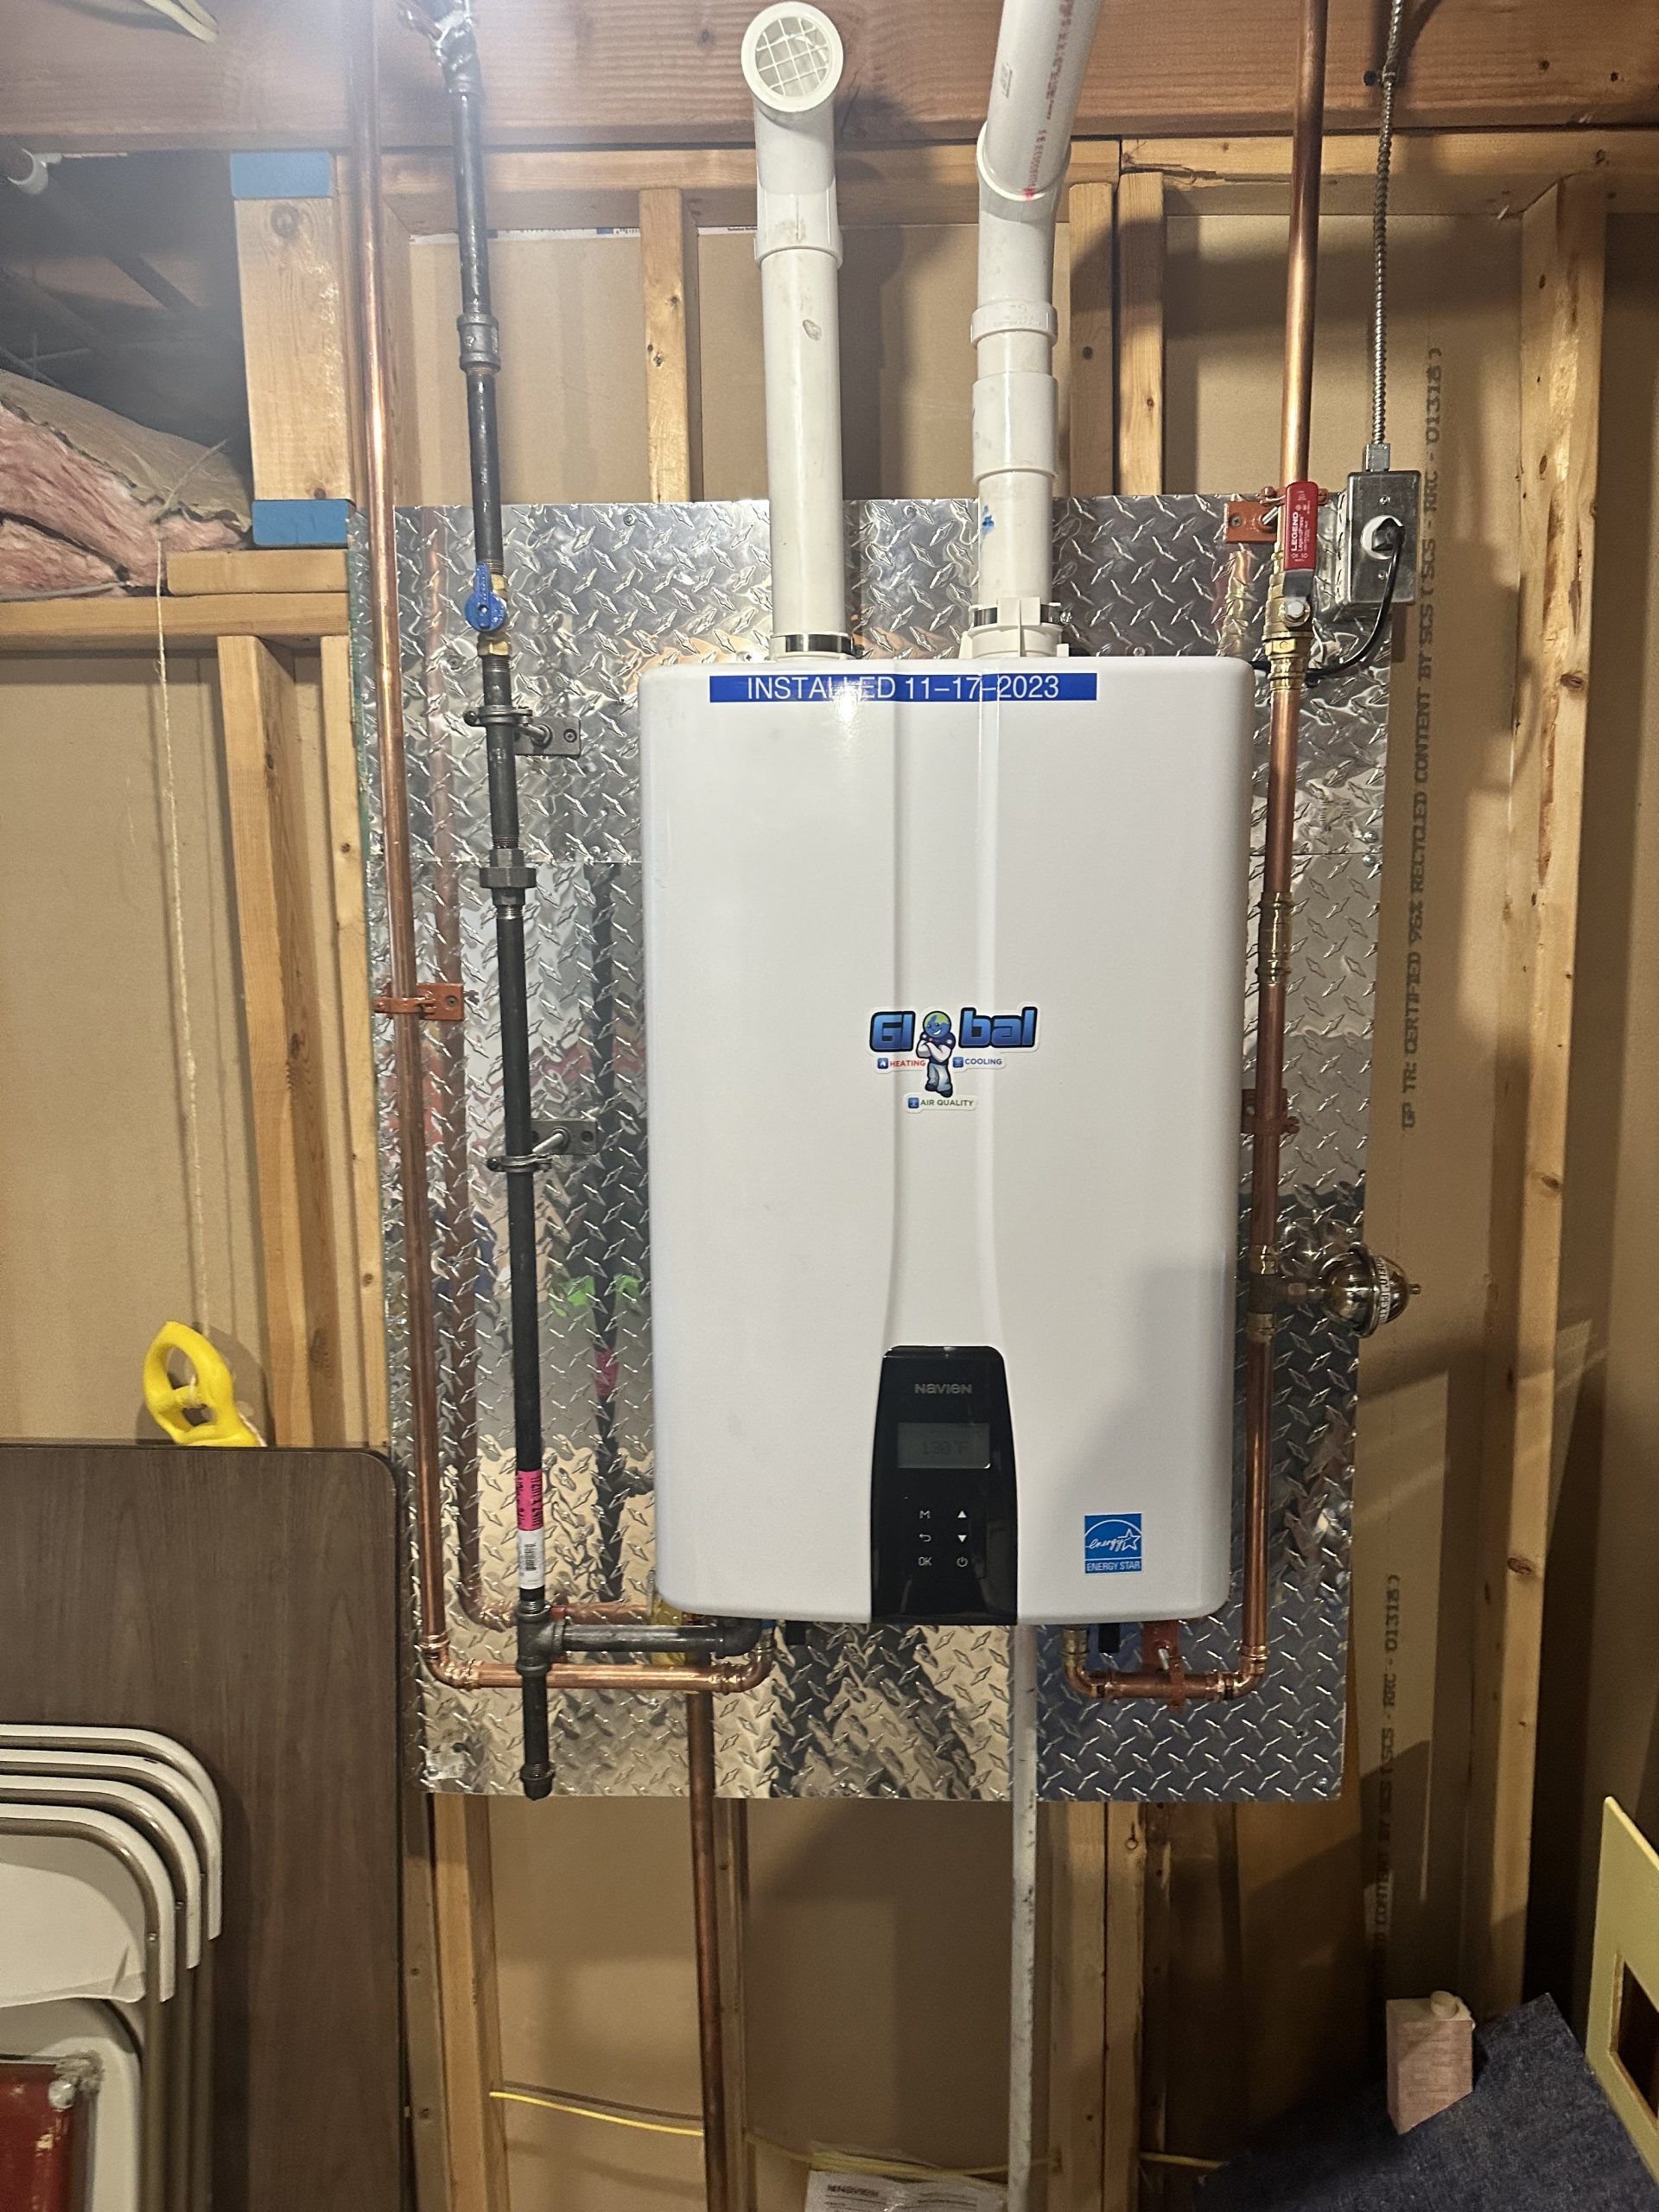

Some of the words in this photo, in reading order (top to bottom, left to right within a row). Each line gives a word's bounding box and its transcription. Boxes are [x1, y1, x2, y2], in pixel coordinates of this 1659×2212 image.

[1424, 471, 1438, 512] RRC
[1418, 604, 1434, 645] SCS
[1417, 652, 1433, 680] BY
[747, 677, 895, 700] INSTALLED
[1414, 687, 1431, 784] CONTENT
[1409, 791, 1427, 894] RECYCLED
[1403, 951, 1421, 1055] CERTIFIED
[890, 1059, 925, 1068] HEATING
[1402, 1103, 1415, 1130] GP
[919, 1510, 931, 1519] M
[918, 1556, 932, 1566] OK
[1086, 1561, 1119, 1572] ENERGY
[1119, 1560, 1141, 1570] STAR
